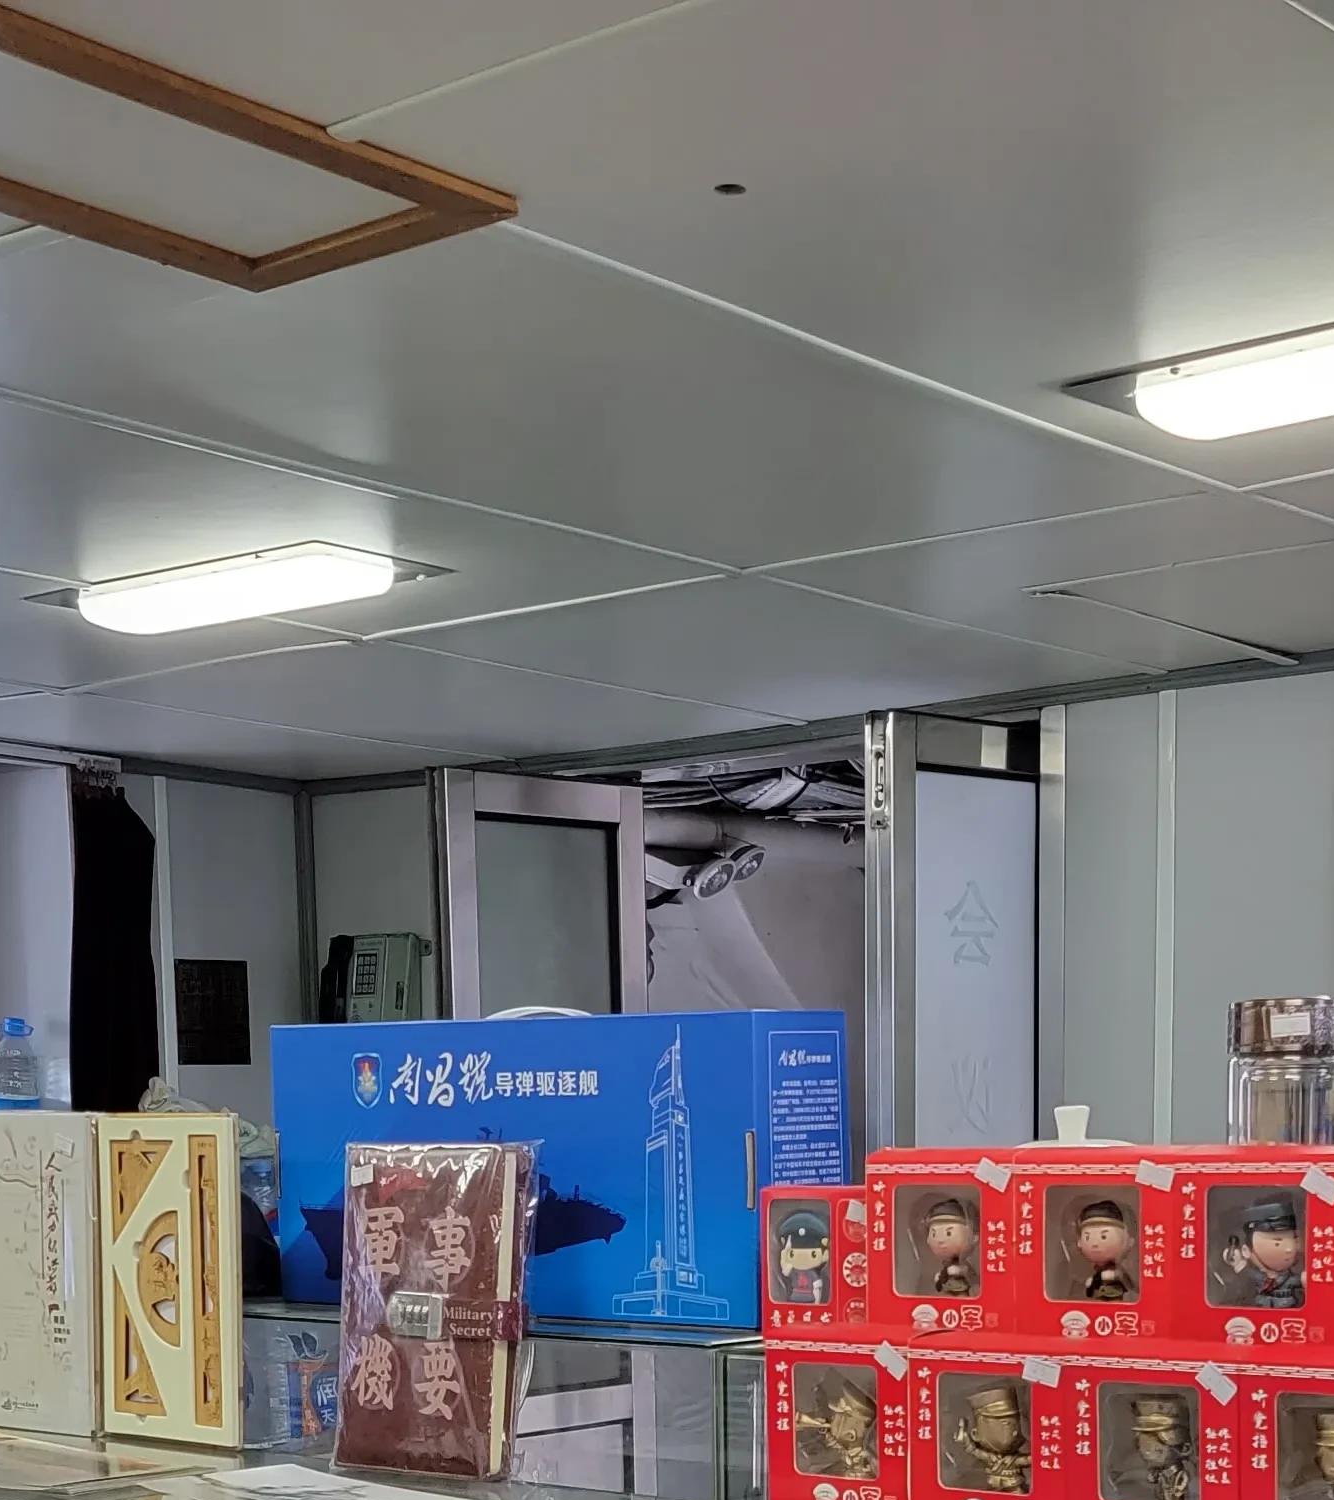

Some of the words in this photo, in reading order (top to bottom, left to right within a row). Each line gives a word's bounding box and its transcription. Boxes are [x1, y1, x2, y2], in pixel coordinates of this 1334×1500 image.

[495, 1068, 600, 1098] 导弹驱逐舰
[443, 1305, 495, 1324] Military
[449, 1321, 492, 1338] Secret
